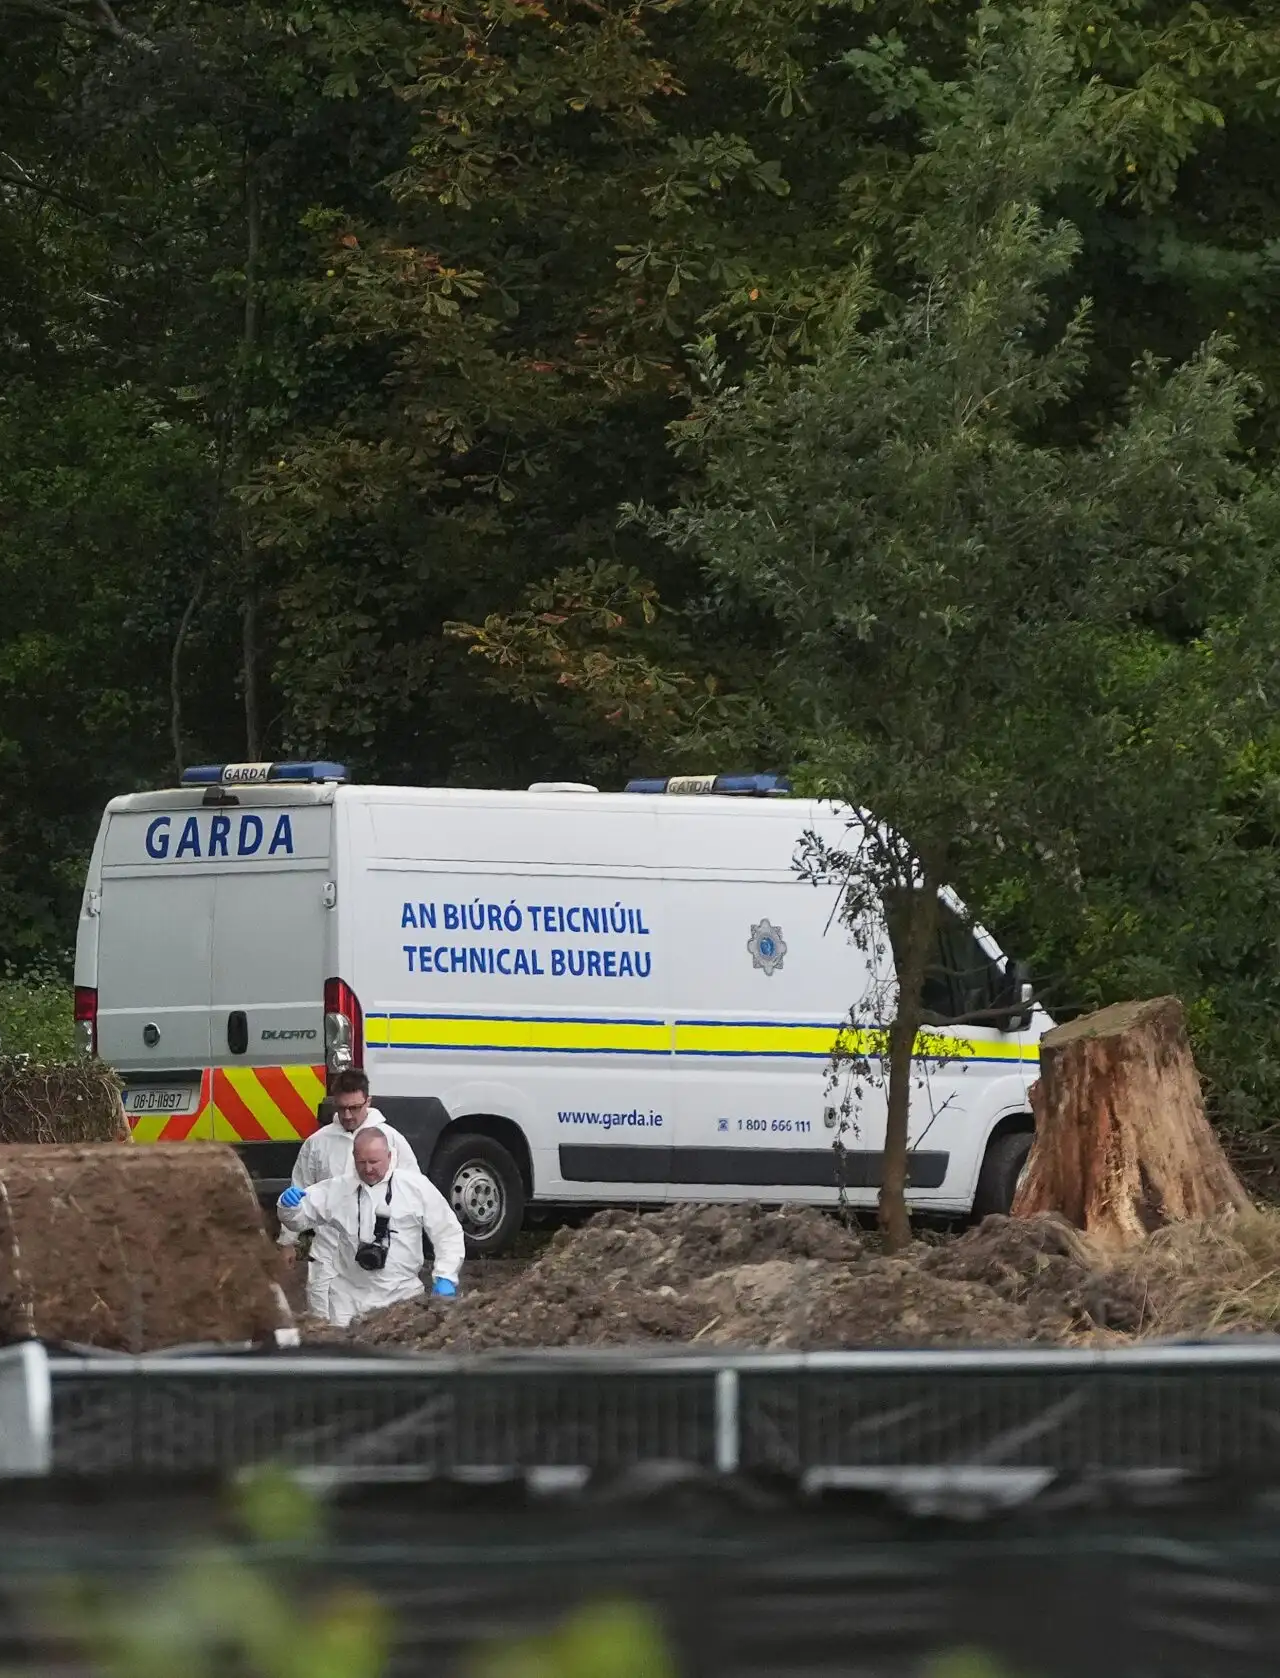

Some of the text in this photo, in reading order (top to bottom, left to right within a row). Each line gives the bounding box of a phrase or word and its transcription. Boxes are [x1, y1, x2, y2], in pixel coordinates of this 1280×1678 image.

[223, 766, 267, 781] GARDA
[144, 813, 294, 859] GARDA
[401, 897, 650, 935] AN BIÚRÓ TEICNIÚIL
[403, 945, 651, 977] TECHNICAL BUREAU
[261, 1029, 318, 1040] DUCATO
[557, 1109, 663, 1129] www.garda.ie
[746, 1119, 767, 1131] 800
[771, 1119, 792, 1132] 666
[794, 1120, 811, 1132] 111
